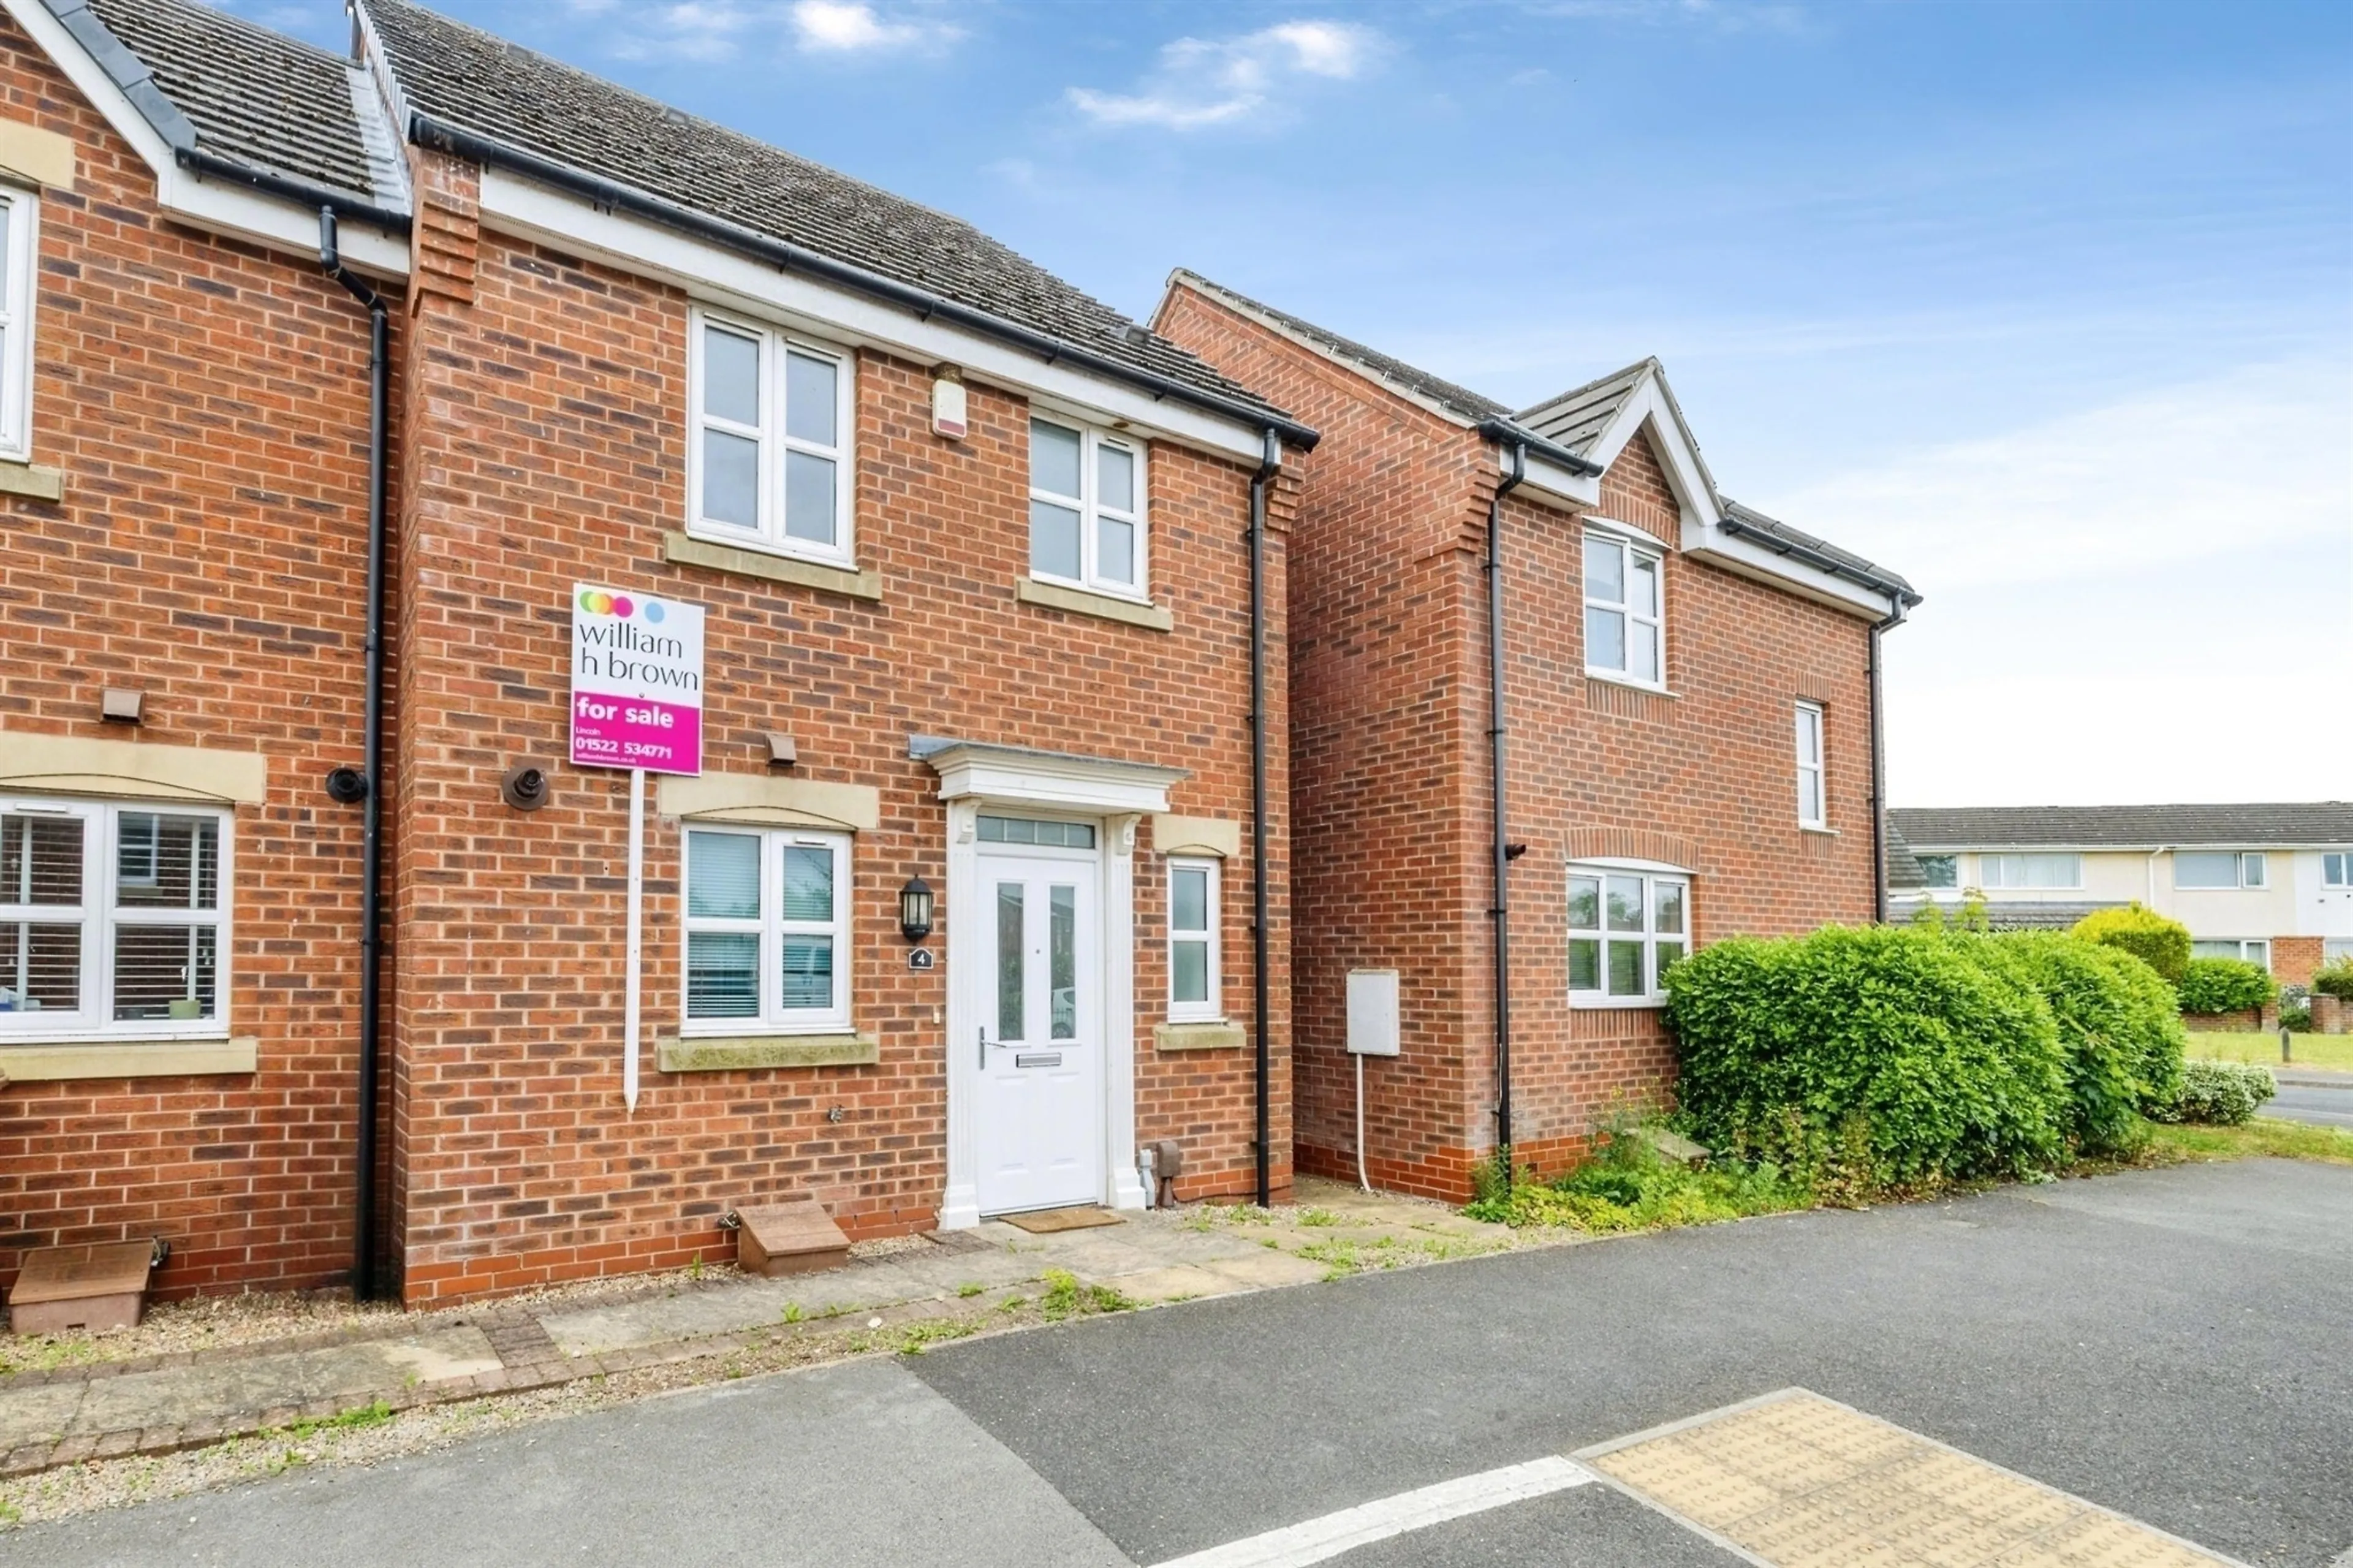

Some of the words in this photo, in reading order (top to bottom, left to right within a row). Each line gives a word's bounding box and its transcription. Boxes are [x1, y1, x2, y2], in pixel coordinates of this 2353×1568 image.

[580, 622, 682, 659] william
[582, 647, 597, 675] h
[609, 651, 697, 690] brown
[577, 697, 618, 721] for
[625, 706, 673, 727] sale
[575, 726, 601, 735] Lincoln
[575, 737, 618, 753] 01522
[624, 742, 672, 759] 534771
[917, 953, 925, 964] 4
